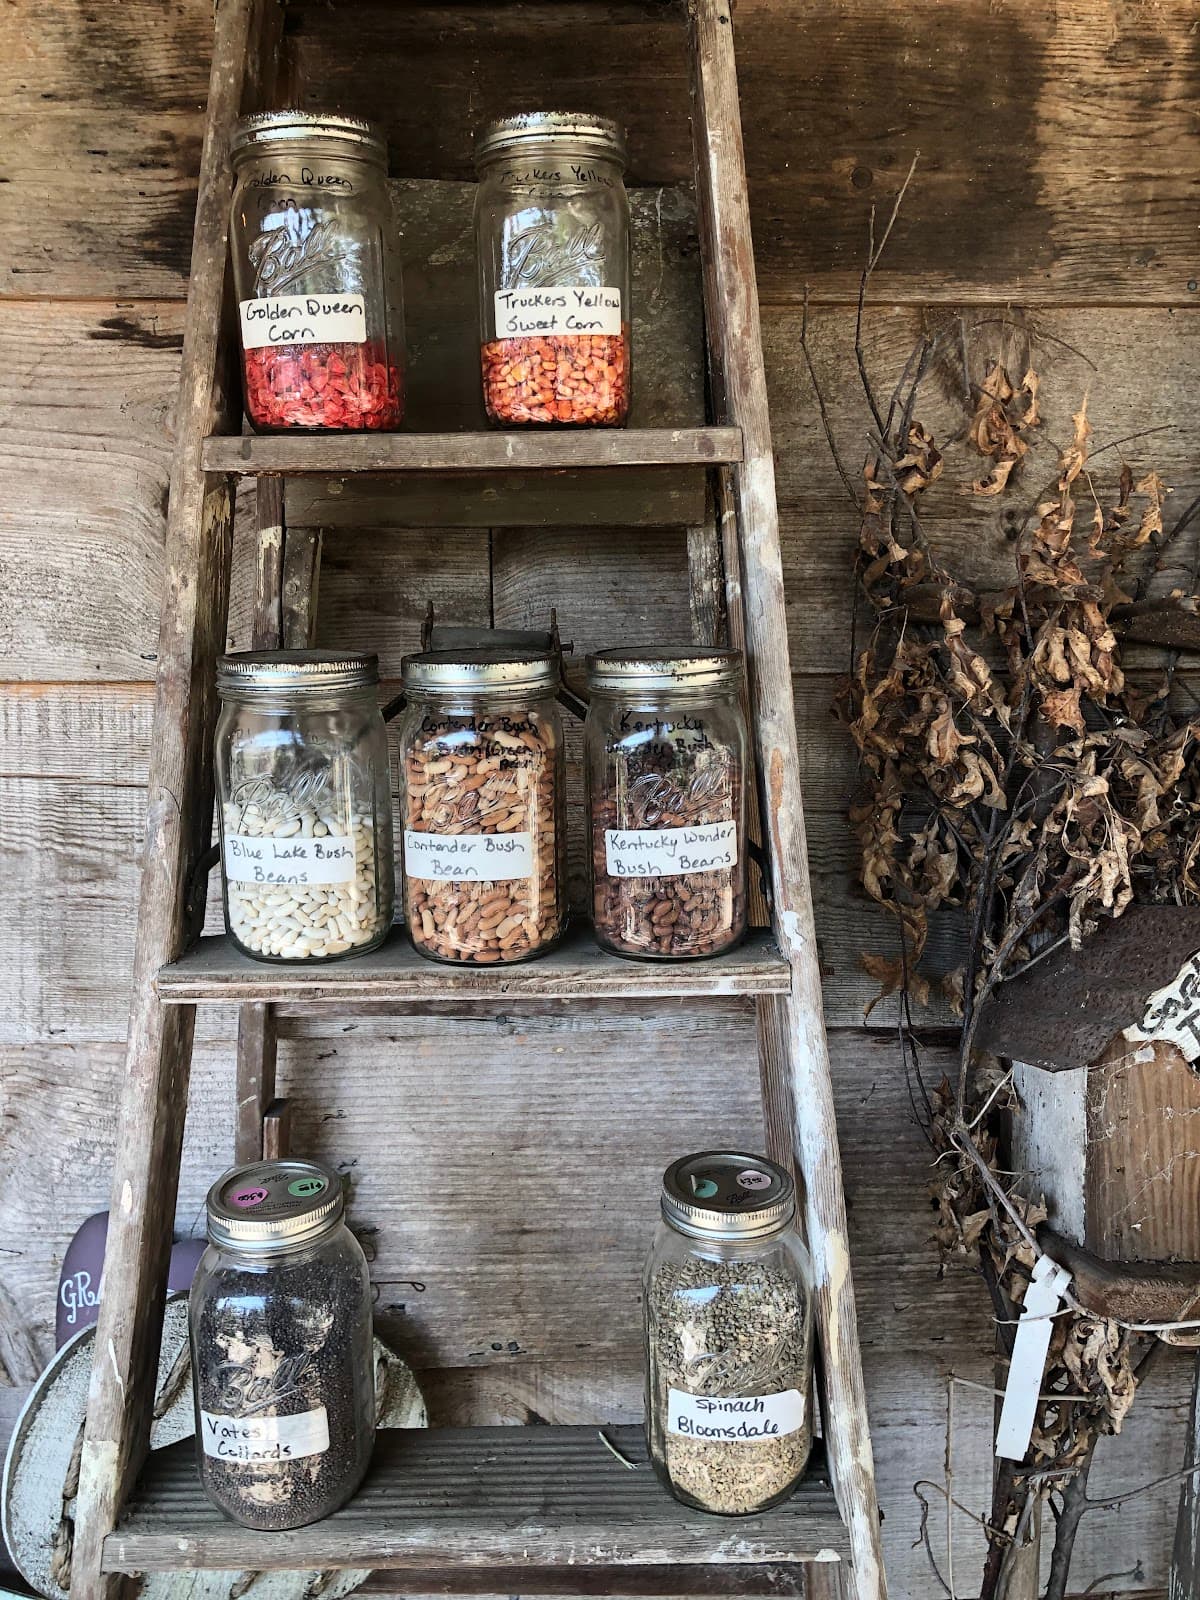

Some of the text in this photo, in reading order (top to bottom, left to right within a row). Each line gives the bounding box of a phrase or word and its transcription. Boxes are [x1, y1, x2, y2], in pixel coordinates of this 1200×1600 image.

[301, 167, 353, 191] Queen
[498, 290, 620, 309] Truckers Yellow
[246, 299, 363, 321] Golden Queen
[268, 324, 315, 342] Corn
[505, 315, 604, 332] Sweet Corn
[230, 840, 354, 860] Blue Lake Bush
[407, 834, 525, 854] Contender Bush
[610, 826, 735, 858] Kentucky Wonder
[430, 859, 479, 876] Bean
[613, 851, 732, 875] Bush Beans
[253, 865, 309, 884] Beans
[695, 1397, 765, 1414] Spinach
[677, 1415, 779, 1438] Bloomsdale
